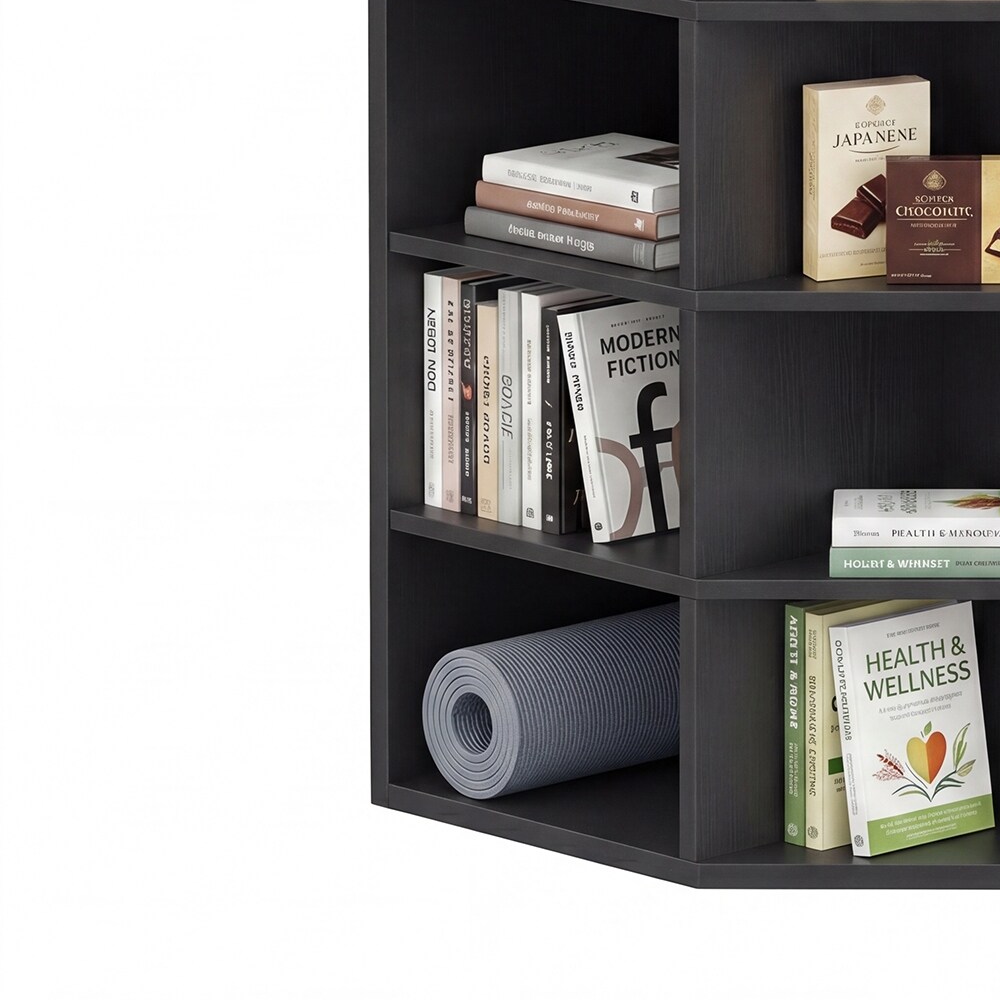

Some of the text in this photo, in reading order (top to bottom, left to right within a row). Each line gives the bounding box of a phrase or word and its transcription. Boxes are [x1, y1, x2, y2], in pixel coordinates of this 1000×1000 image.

[866, 635, 967, 675] HEALTH &
[863, 660, 972, 701] WELLNESS
